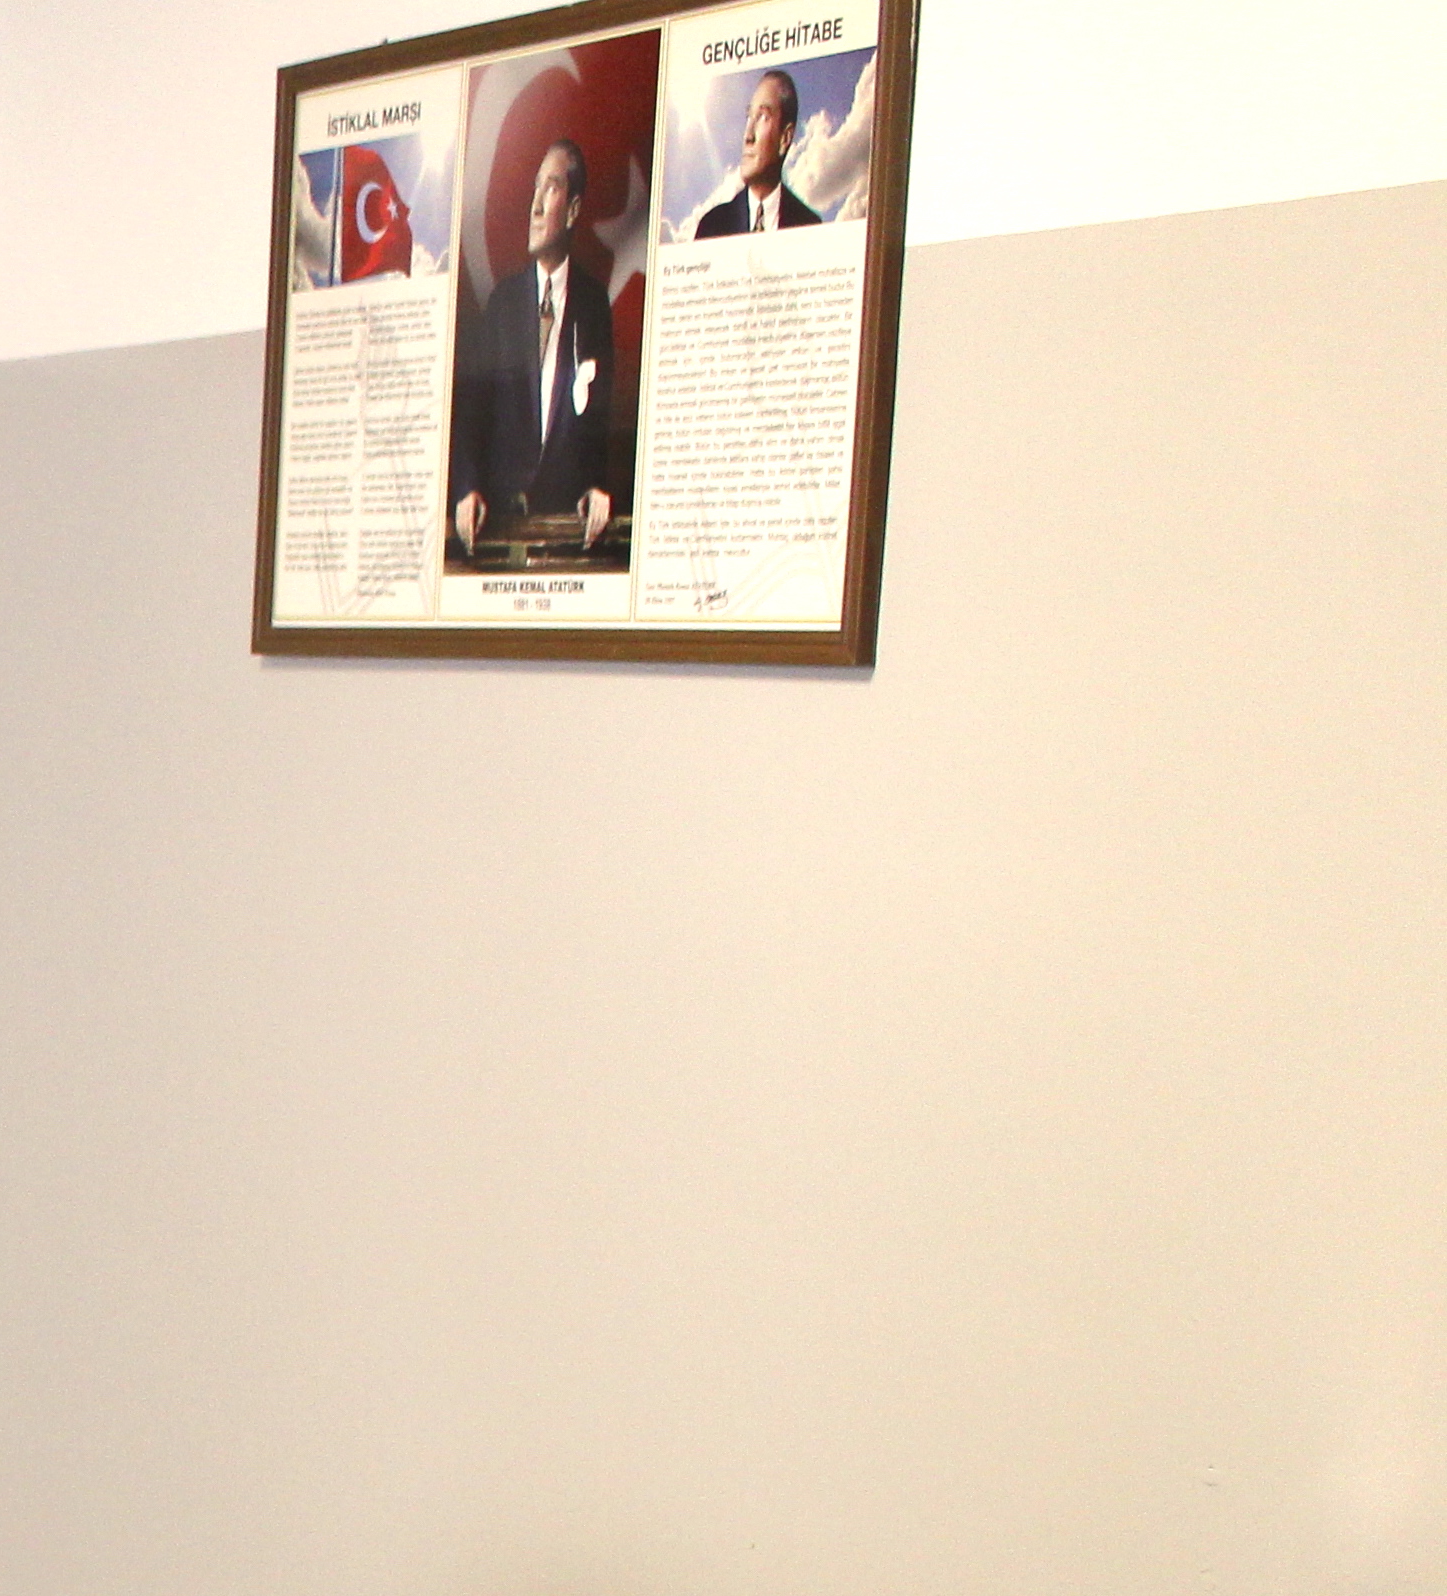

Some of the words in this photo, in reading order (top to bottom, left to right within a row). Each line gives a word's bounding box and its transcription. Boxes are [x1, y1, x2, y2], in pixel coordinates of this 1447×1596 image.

[702, 26, 782, 65] GENÇLİĞE
[785, 17, 844, 50] HİTABE
[327, 109, 380, 137] İSTİKLAL
[382, 101, 422, 127] MARŞI
